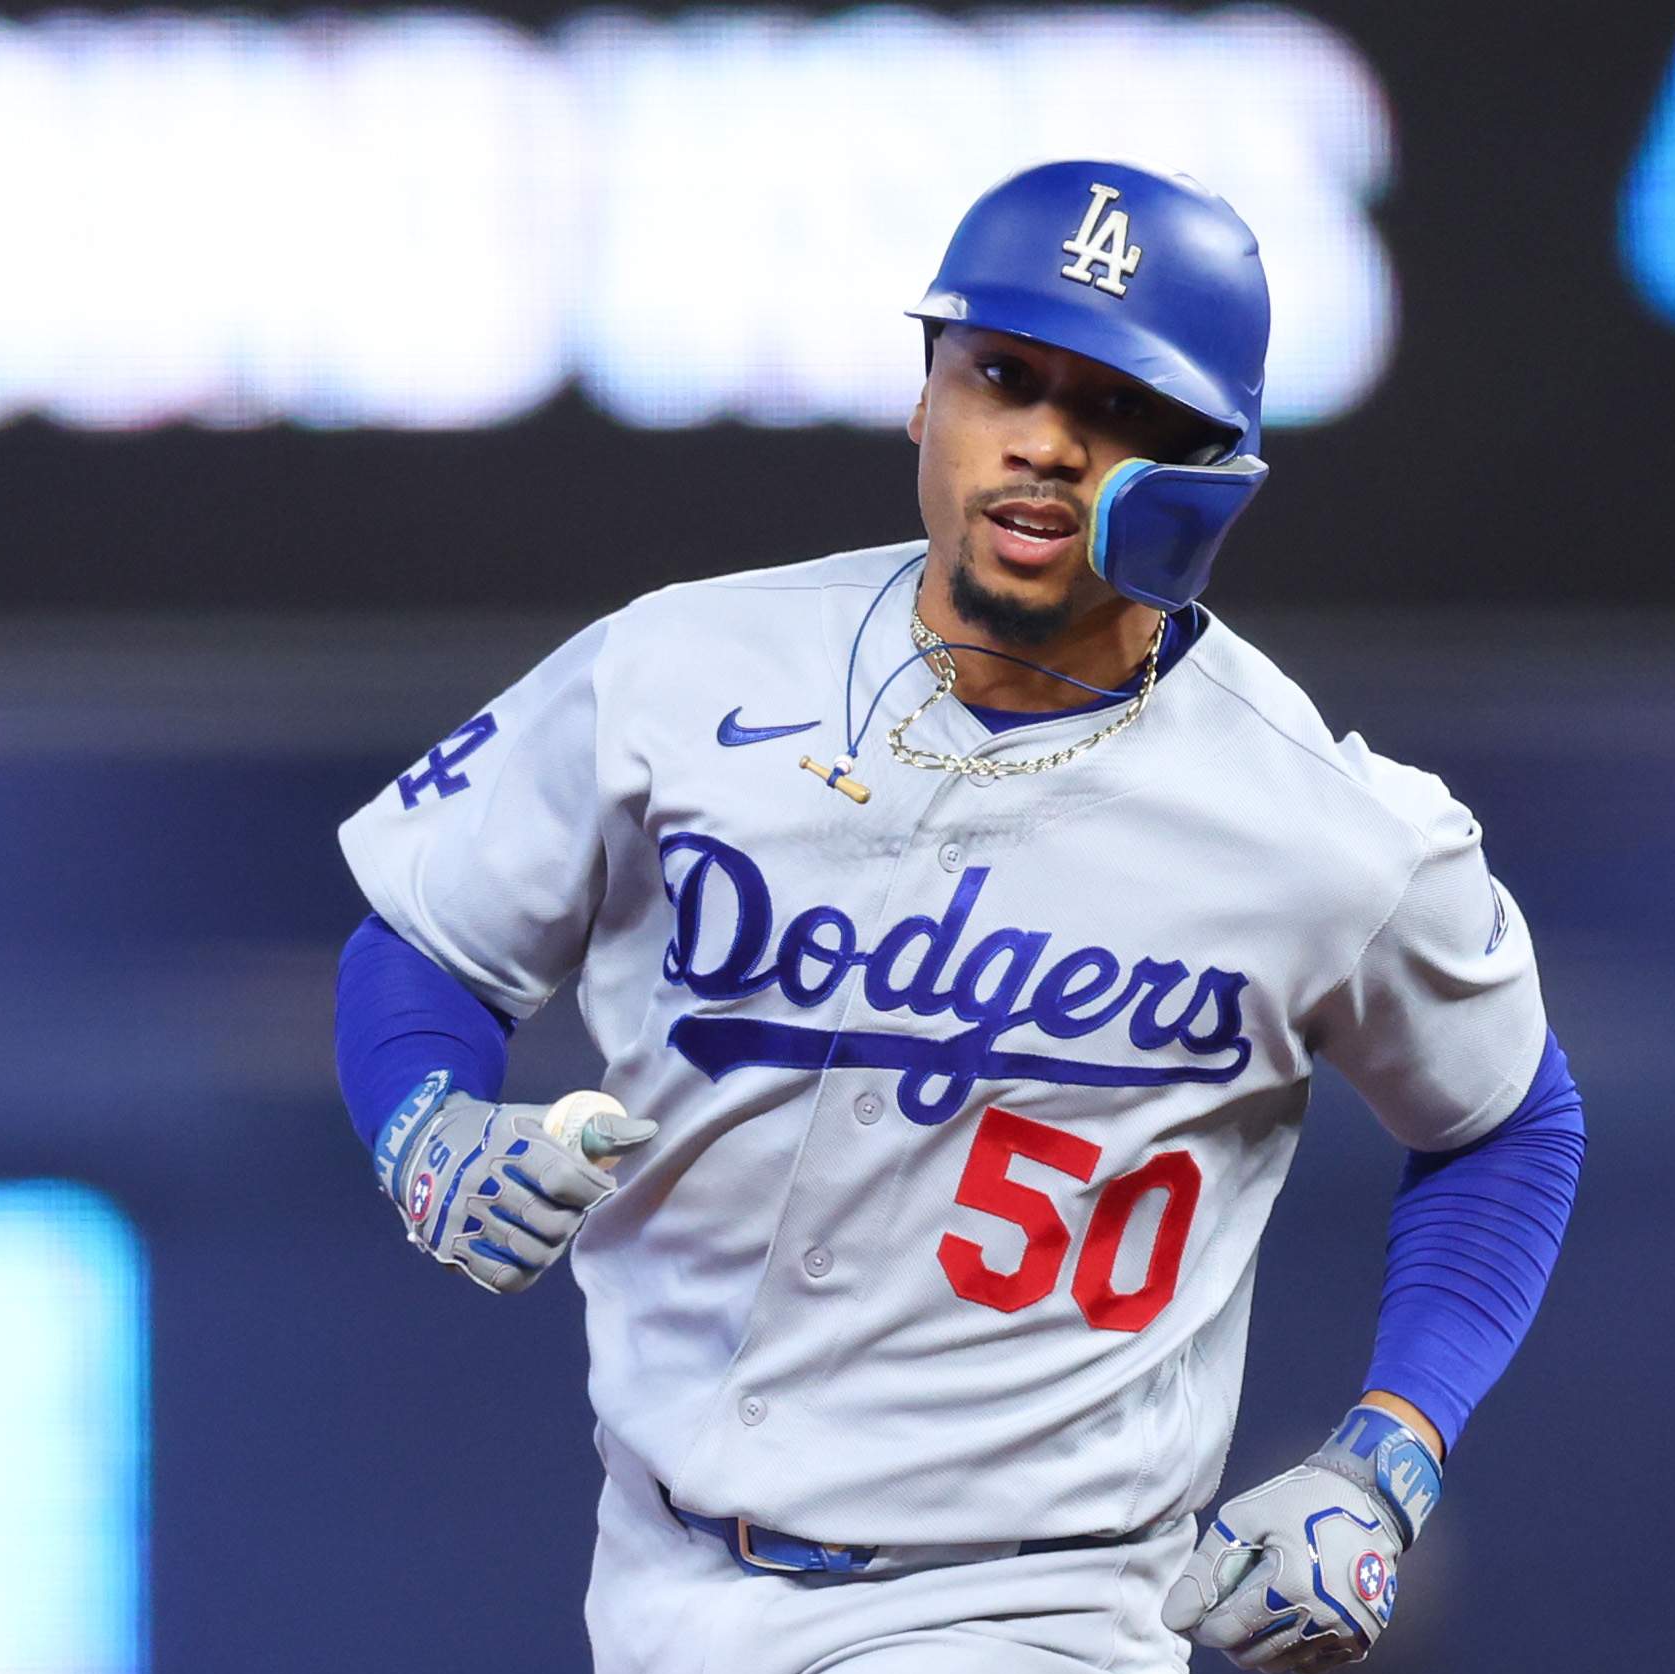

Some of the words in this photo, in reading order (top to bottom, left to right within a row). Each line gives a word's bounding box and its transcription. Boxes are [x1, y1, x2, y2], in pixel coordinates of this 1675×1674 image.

[1061, 182, 1141, 298] LA
[396, 711, 499, 811] A
[659, 831, 1252, 1126] Dodgers
[936, 1106, 1203, 1334] 50
